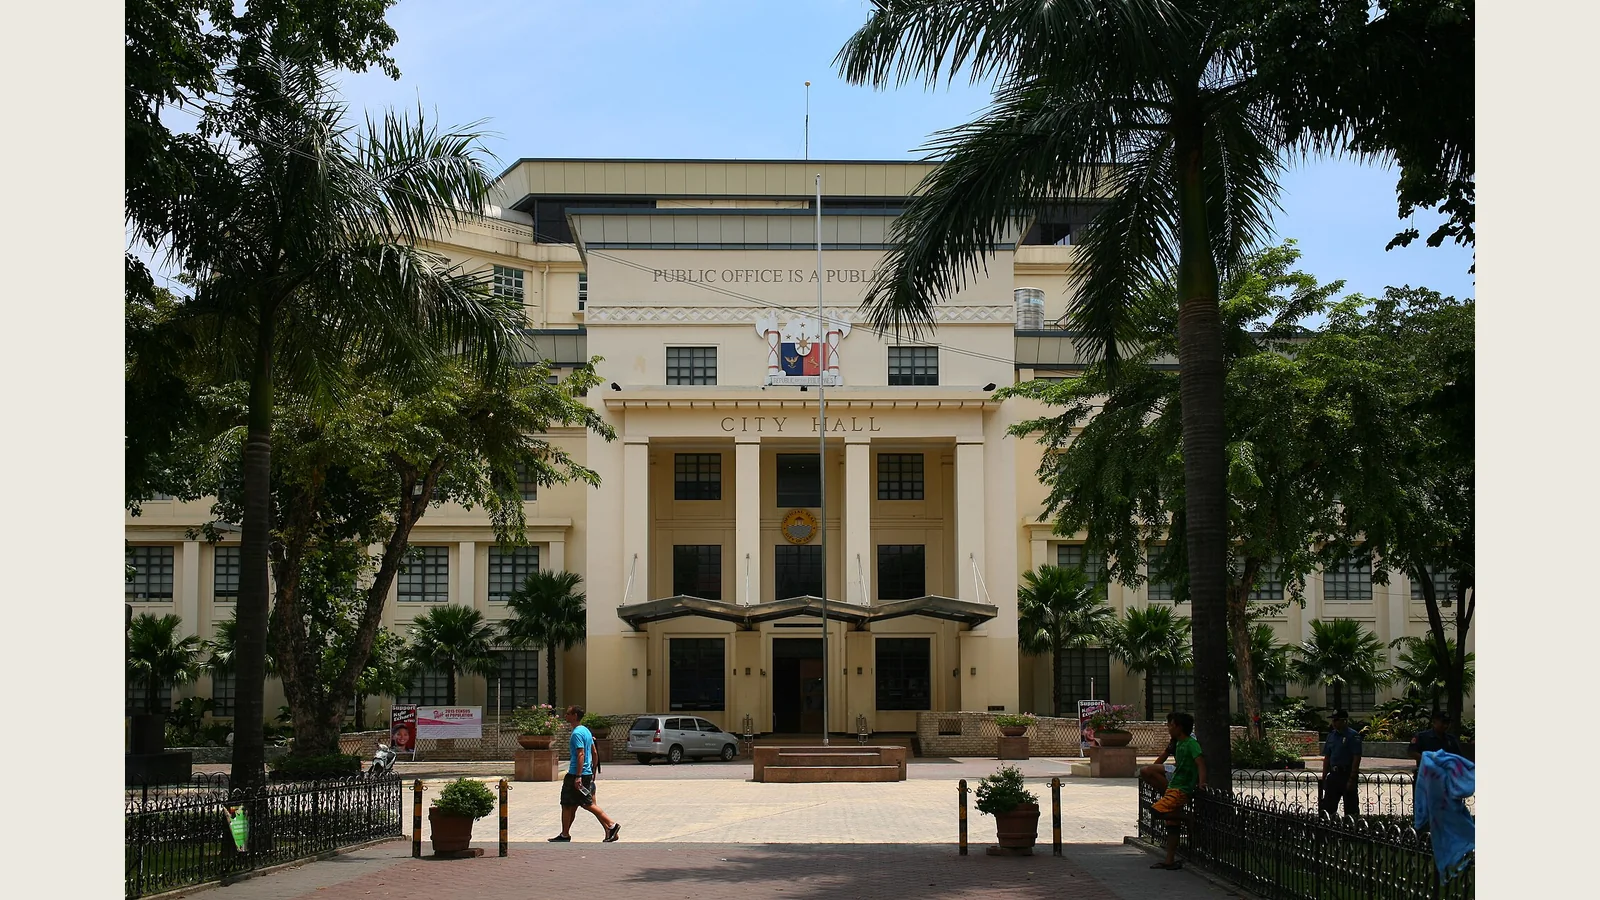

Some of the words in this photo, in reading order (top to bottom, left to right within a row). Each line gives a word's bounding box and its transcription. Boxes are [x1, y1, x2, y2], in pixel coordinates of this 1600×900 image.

[652, 269, 717, 283] PUBLIC
[721, 269, 784, 283] OFFICE
[787, 269, 804, 283] IS
[808, 269, 820, 283] A
[720, 416, 788, 432] CITY
[811, 416, 881, 432] HALL
